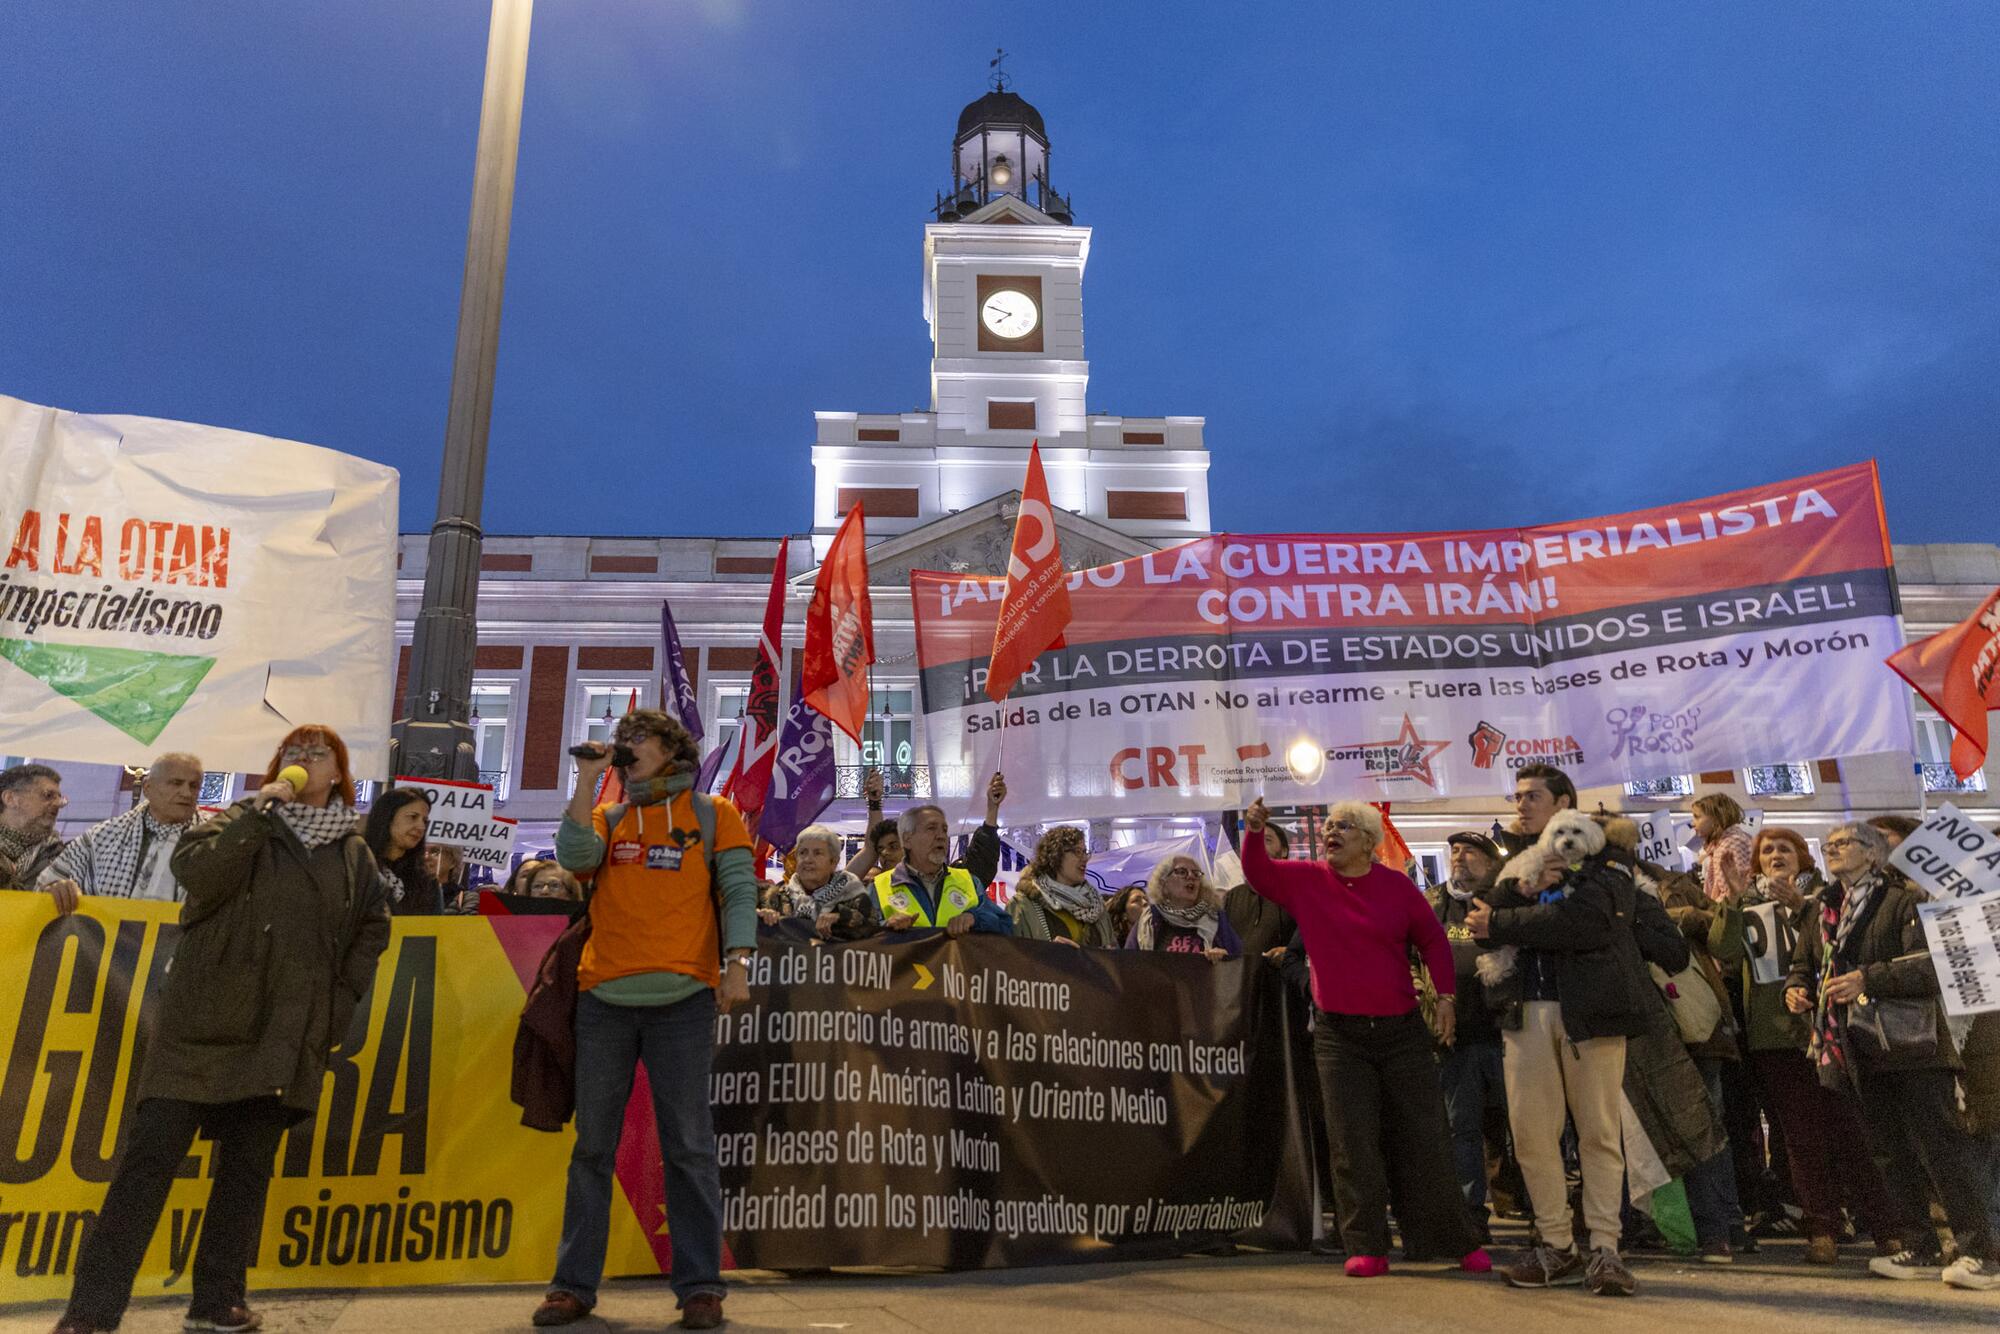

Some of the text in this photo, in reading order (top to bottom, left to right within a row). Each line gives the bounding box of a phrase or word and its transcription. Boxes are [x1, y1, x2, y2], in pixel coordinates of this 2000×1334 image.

[5, 510, 231, 588] A LA OTAN
[1143, 546, 1210, 585] LA
[1220, 541, 1432, 578] GUERRA
[1444, 488, 1838, 574] IMPERIALISTA
[0, 574, 223, 640] imperialismo
[1197, 575, 1560, 625] CONTRA IRÁN!
[963, 582, 1857, 699] ¡PR LA DERROTA DE ESTADOS UNIDOS E ISRAEL!
[966, 630, 1870, 734] Salida de la OTAN No al rearme Fuera las bases de Rota y Morón
[1110, 744, 1207, 790] CRT
[1325, 747, 1399, 762] Corriente
[1365, 759, 1400, 774] Roja
[1505, 735, 1581, 755] CONTRA
[425, 789, 485, 810] O A LA
[428, 820, 488, 841] ERRA!
[462, 846, 508, 864] ERRA!
[489, 824, 509, 840] LA
[1637, 838, 1672, 861] AR!
[1925, 815, 1985, 852] ¡NO
[780, 946, 808, 986] de
[815, 946, 835, 985] la
[843, 949, 893, 990] OTAN
[943, 963, 965, 1001] No
[970, 968, 988, 1004] al
[996, 970, 1070, 1012] Rearme
[739, 1004, 760, 1044] al
[768, 1005, 873, 1044] comercio
[880, 1009, 903, 1048] de
[910, 1018, 968, 1055] armas
[972, 1027, 982, 1063] y
[987, 1029, 999, 1060] a
[1006, 1023, 1036, 1063] las
[1043, 1029, 1143, 1071] relaciones
[1149, 1043, 1182, 1073] con
[1189, 1039, 1245, 1075] Israel
[709, 1061, 1167, 1126] uera EEUU de América Latina y Oriente Medio
[714, 1122, 1000, 1174] era bases de Rota y Morón
[163, 1208, 204, 1288] y
[278, 1186, 513, 1268] sionismo
[720, 1184, 1264, 1242] idaridad con los pueblos agredidos por el imperialismo
